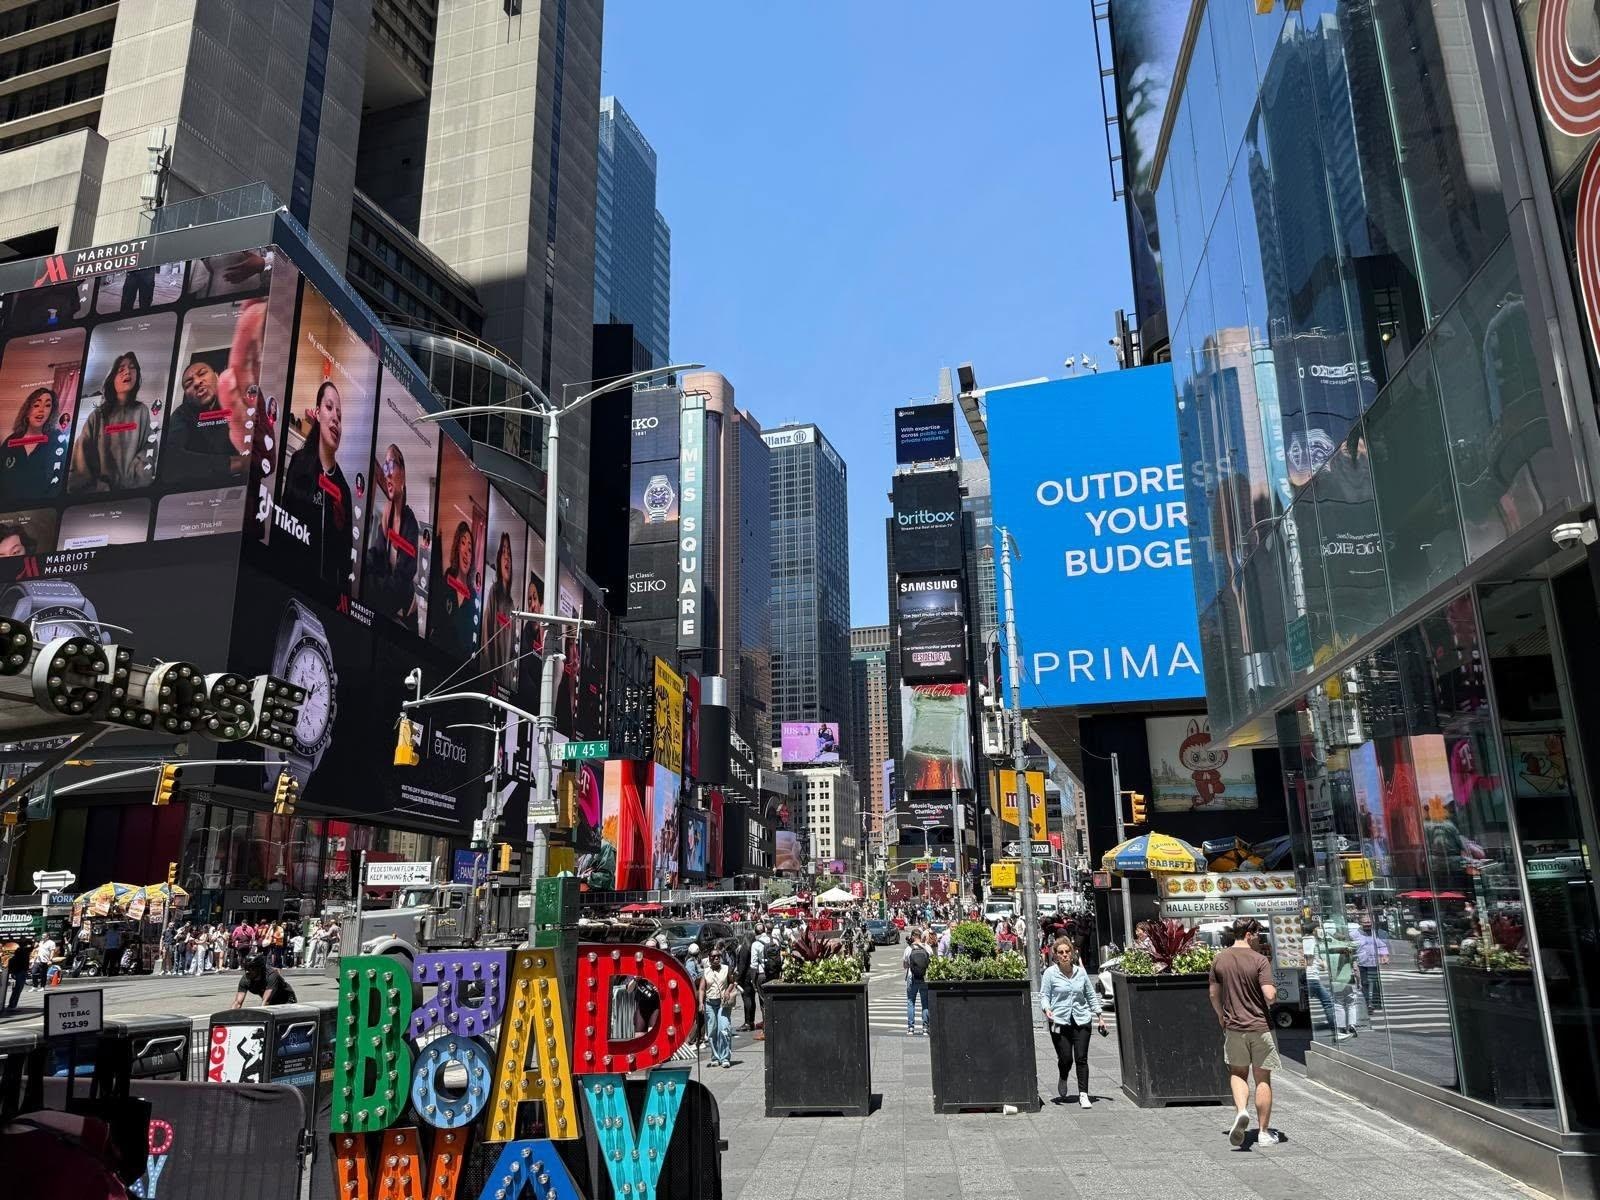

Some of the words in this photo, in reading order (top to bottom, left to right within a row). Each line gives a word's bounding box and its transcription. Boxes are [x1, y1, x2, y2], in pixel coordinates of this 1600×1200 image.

[77, 240, 148, 263] MARRIOTT
[75, 255, 137, 276] MARQUIS
[385, 345, 414, 382] MARRIOTT
[384, 357, 410, 391] MARQUIS
[682, 410, 697, 502] TIMES
[274, 504, 311, 546] TikTok
[898, 509, 955, 525] britbox
[1084, 501, 1189, 537] YOUR
[46, 551, 97, 564] MARRIOTT
[44, 562, 89, 575] MARQUIS
[681, 517, 697, 635] SQUARE
[630, 579, 667, 593] SEIKO
[900, 579, 958, 593] SAMSUNG
[351, 600, 376, 618] MARRIOTT
[350, 609, 372, 626] MARQUIS
[1034, 641, 1201, 685] PRIMA
[567, 744, 577, 757] W
[582, 743, 595, 757] 45
[599, 743, 607, 752] St
[1150, 859, 1192, 869] SABRETT
[460, 866, 486, 879] PANRA
[52, 895, 75, 903] YORK
[1166, 903, 1194, 912] HALAL
[1194, 902, 1230, 911] EXPRESS
[1266, 899, 1279, 907] Chef
[62, 1020, 89, 1030] $23.99
